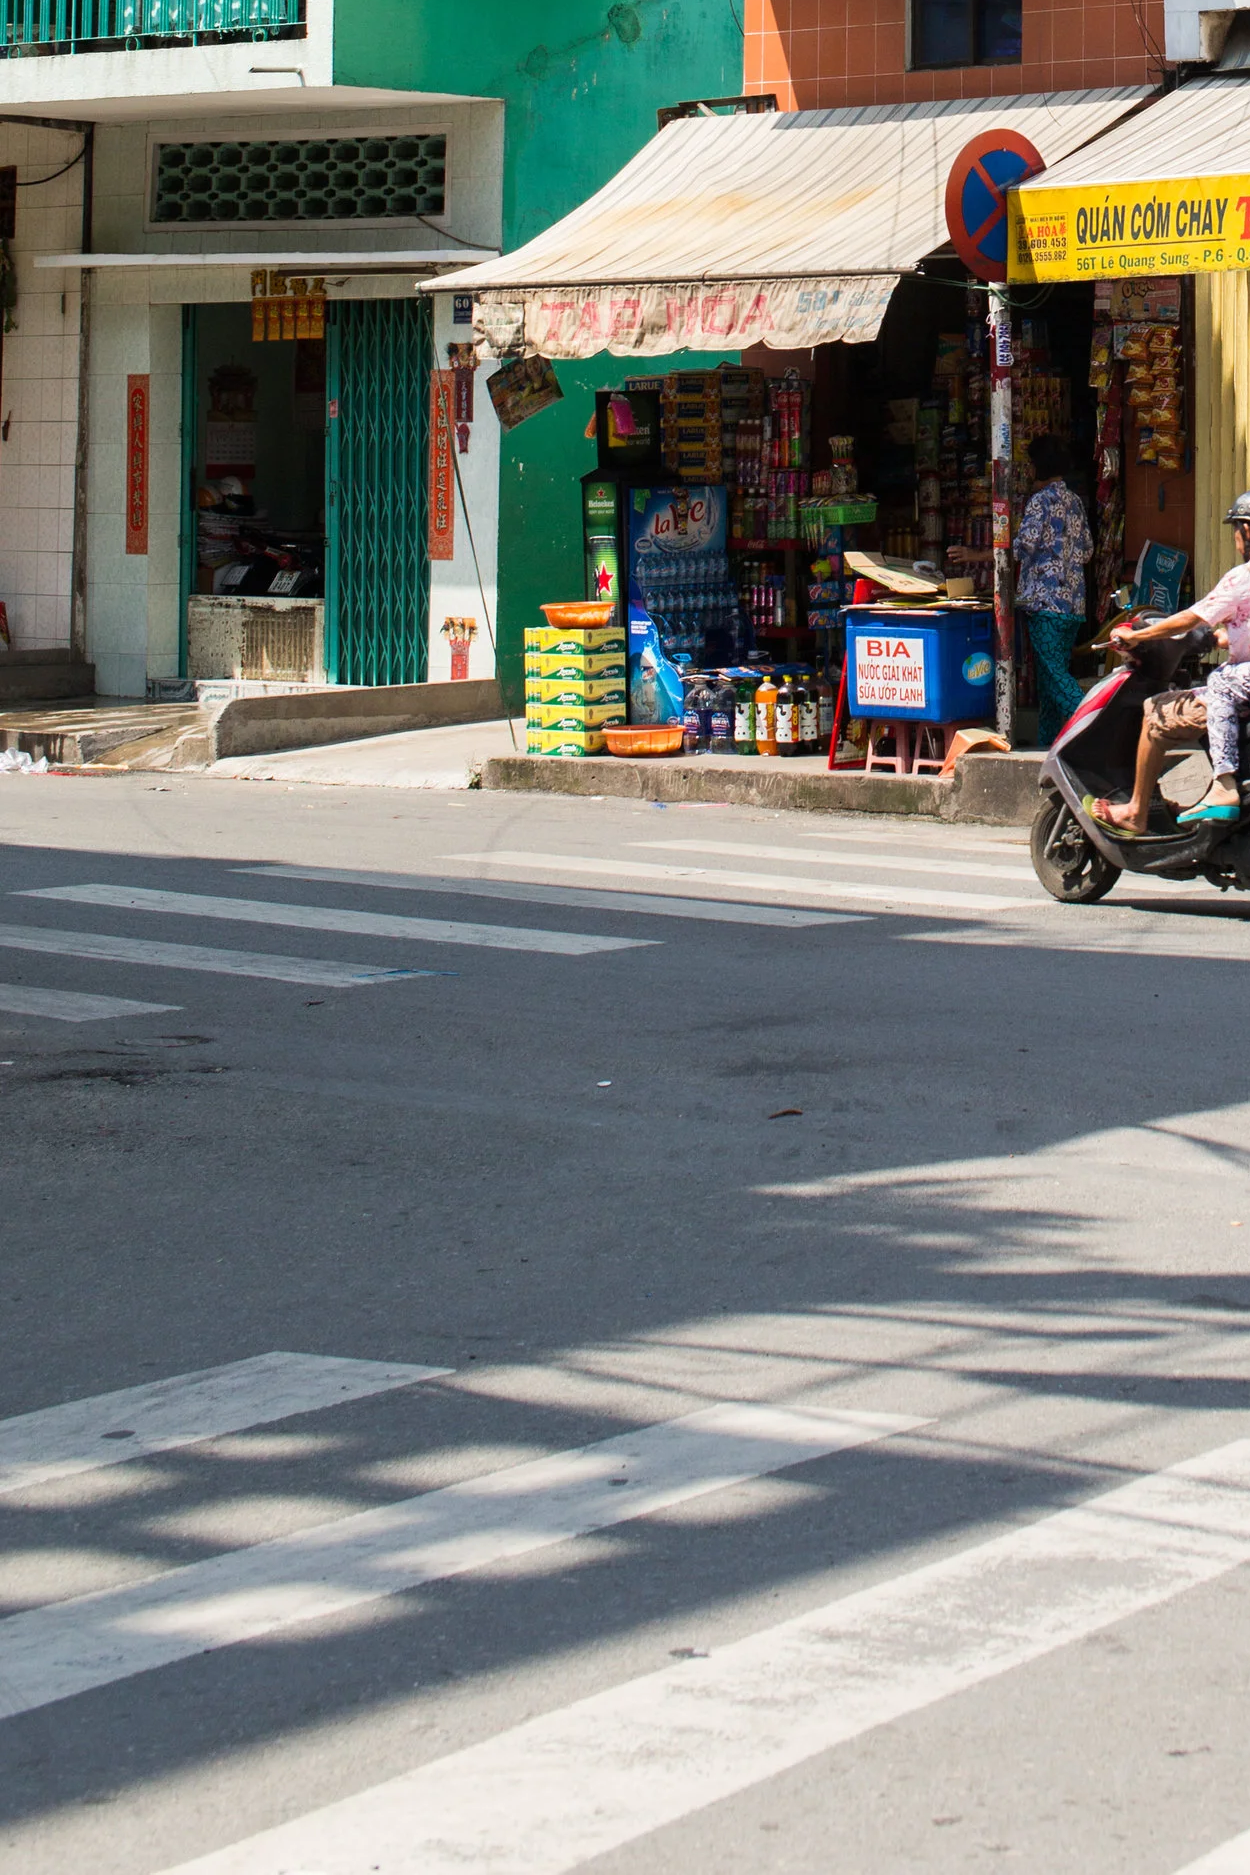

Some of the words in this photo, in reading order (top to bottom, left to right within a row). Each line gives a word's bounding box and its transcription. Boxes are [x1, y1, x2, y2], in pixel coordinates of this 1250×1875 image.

[1037, 222, 1058, 238] HÒA
[1076, 195, 1126, 245] QUÁN
[1130, 195, 1172, 240] CƠM
[1175, 198, 1229, 237] CHAY
[1077, 256, 1097, 271] 56T
[1101, 255, 1115, 270] Lê
[1118, 253, 1156, 272] Quang
[1160, 251, 1190, 270] Sung
[1203, 248, 1225, 263] P.6
[455, 297, 470, 310] 60
[539, 299, 643, 349] TẠP
[665, 285, 776, 338] HÓA
[629, 380, 661, 392] LARUE
[866, 640, 911, 658] BIA
[858, 658, 881, 681] NƯỚC
[882, 660, 900, 682] GIẢI
[902, 661, 923, 683] KHÁT
[859, 682, 877, 700] SỮA
[878, 682, 897, 701] ƯỚP
[899, 687, 924, 705] LẠNH
